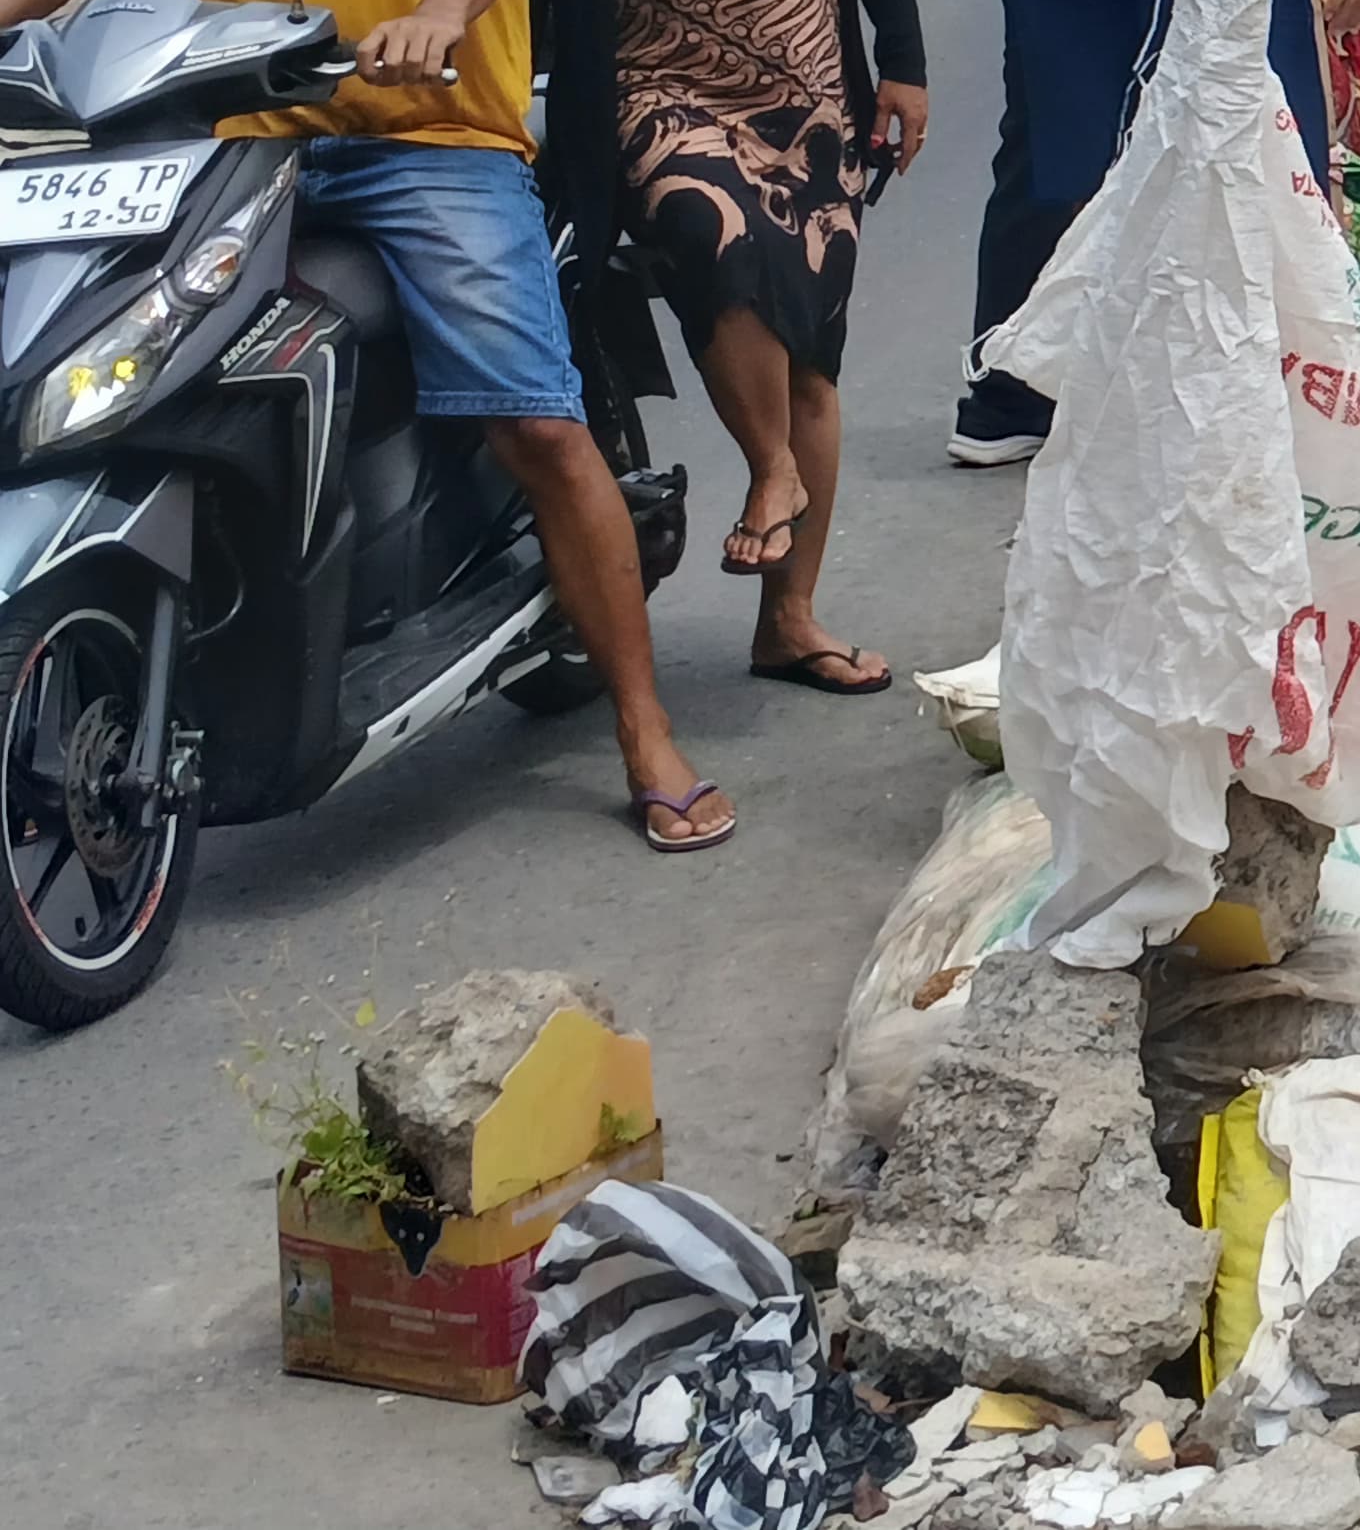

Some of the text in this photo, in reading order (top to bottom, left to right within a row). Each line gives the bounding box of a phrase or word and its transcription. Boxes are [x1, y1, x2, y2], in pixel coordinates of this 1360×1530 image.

[15, 162, 180, 205] 5846 TP
[219, 296, 292, 371] HONDA
